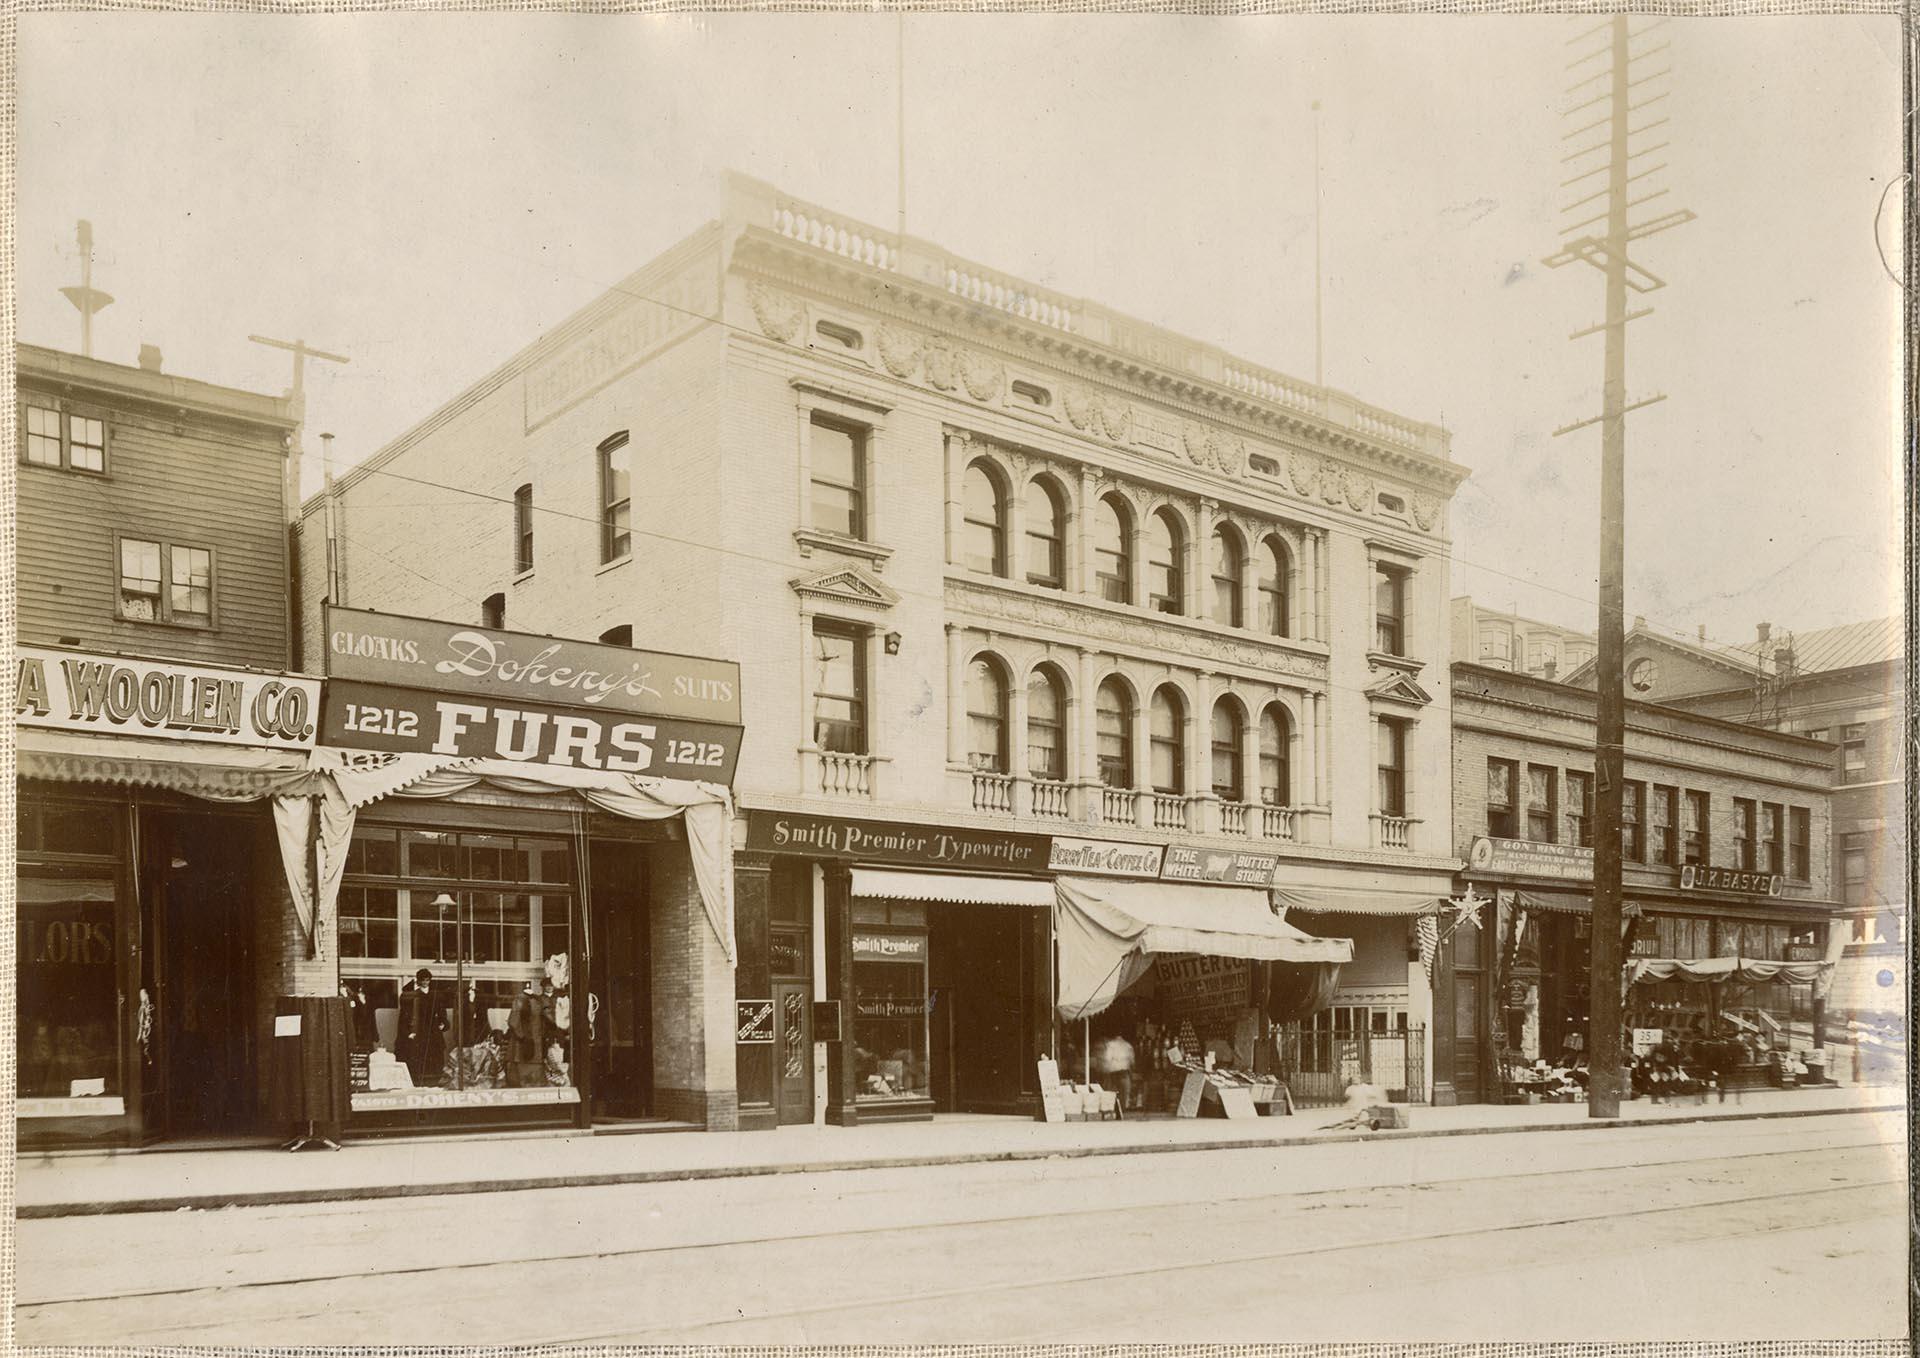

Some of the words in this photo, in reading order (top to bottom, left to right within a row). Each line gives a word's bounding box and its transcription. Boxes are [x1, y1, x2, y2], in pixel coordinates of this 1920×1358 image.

[434, 630, 662, 704] Doheny's
[674, 674, 733, 702] SUITS
[60, 658, 244, 736] WOOLEN
[251, 680, 315, 742] CO.
[343, 703, 419, 738] 1212
[431, 700, 657, 773] FURS
[664, 739, 725, 767] 1212
[773, 819, 838, 850] Smith
[840, 825, 926, 856] Premier
[928, 833, 1032, 861] Typewriter
[1502, 840, 1530, 852] GON
[1536, 844, 1565, 855] WING
[1080, 846, 1101, 869] TEA
[1173, 849, 1200, 866] THE
[1235, 853, 1275, 871] BUTTER
[1163, 864, 1202, 880] WHITE
[1234, 869, 1267, 884] STORE
[852, 936, 881, 953] Smith
[880, 938, 921, 955] Premier
[1160, 958, 1221, 981] BUTTER
[857, 1001, 886, 1016] Smith
[886, 1001, 924, 1017] Premier
